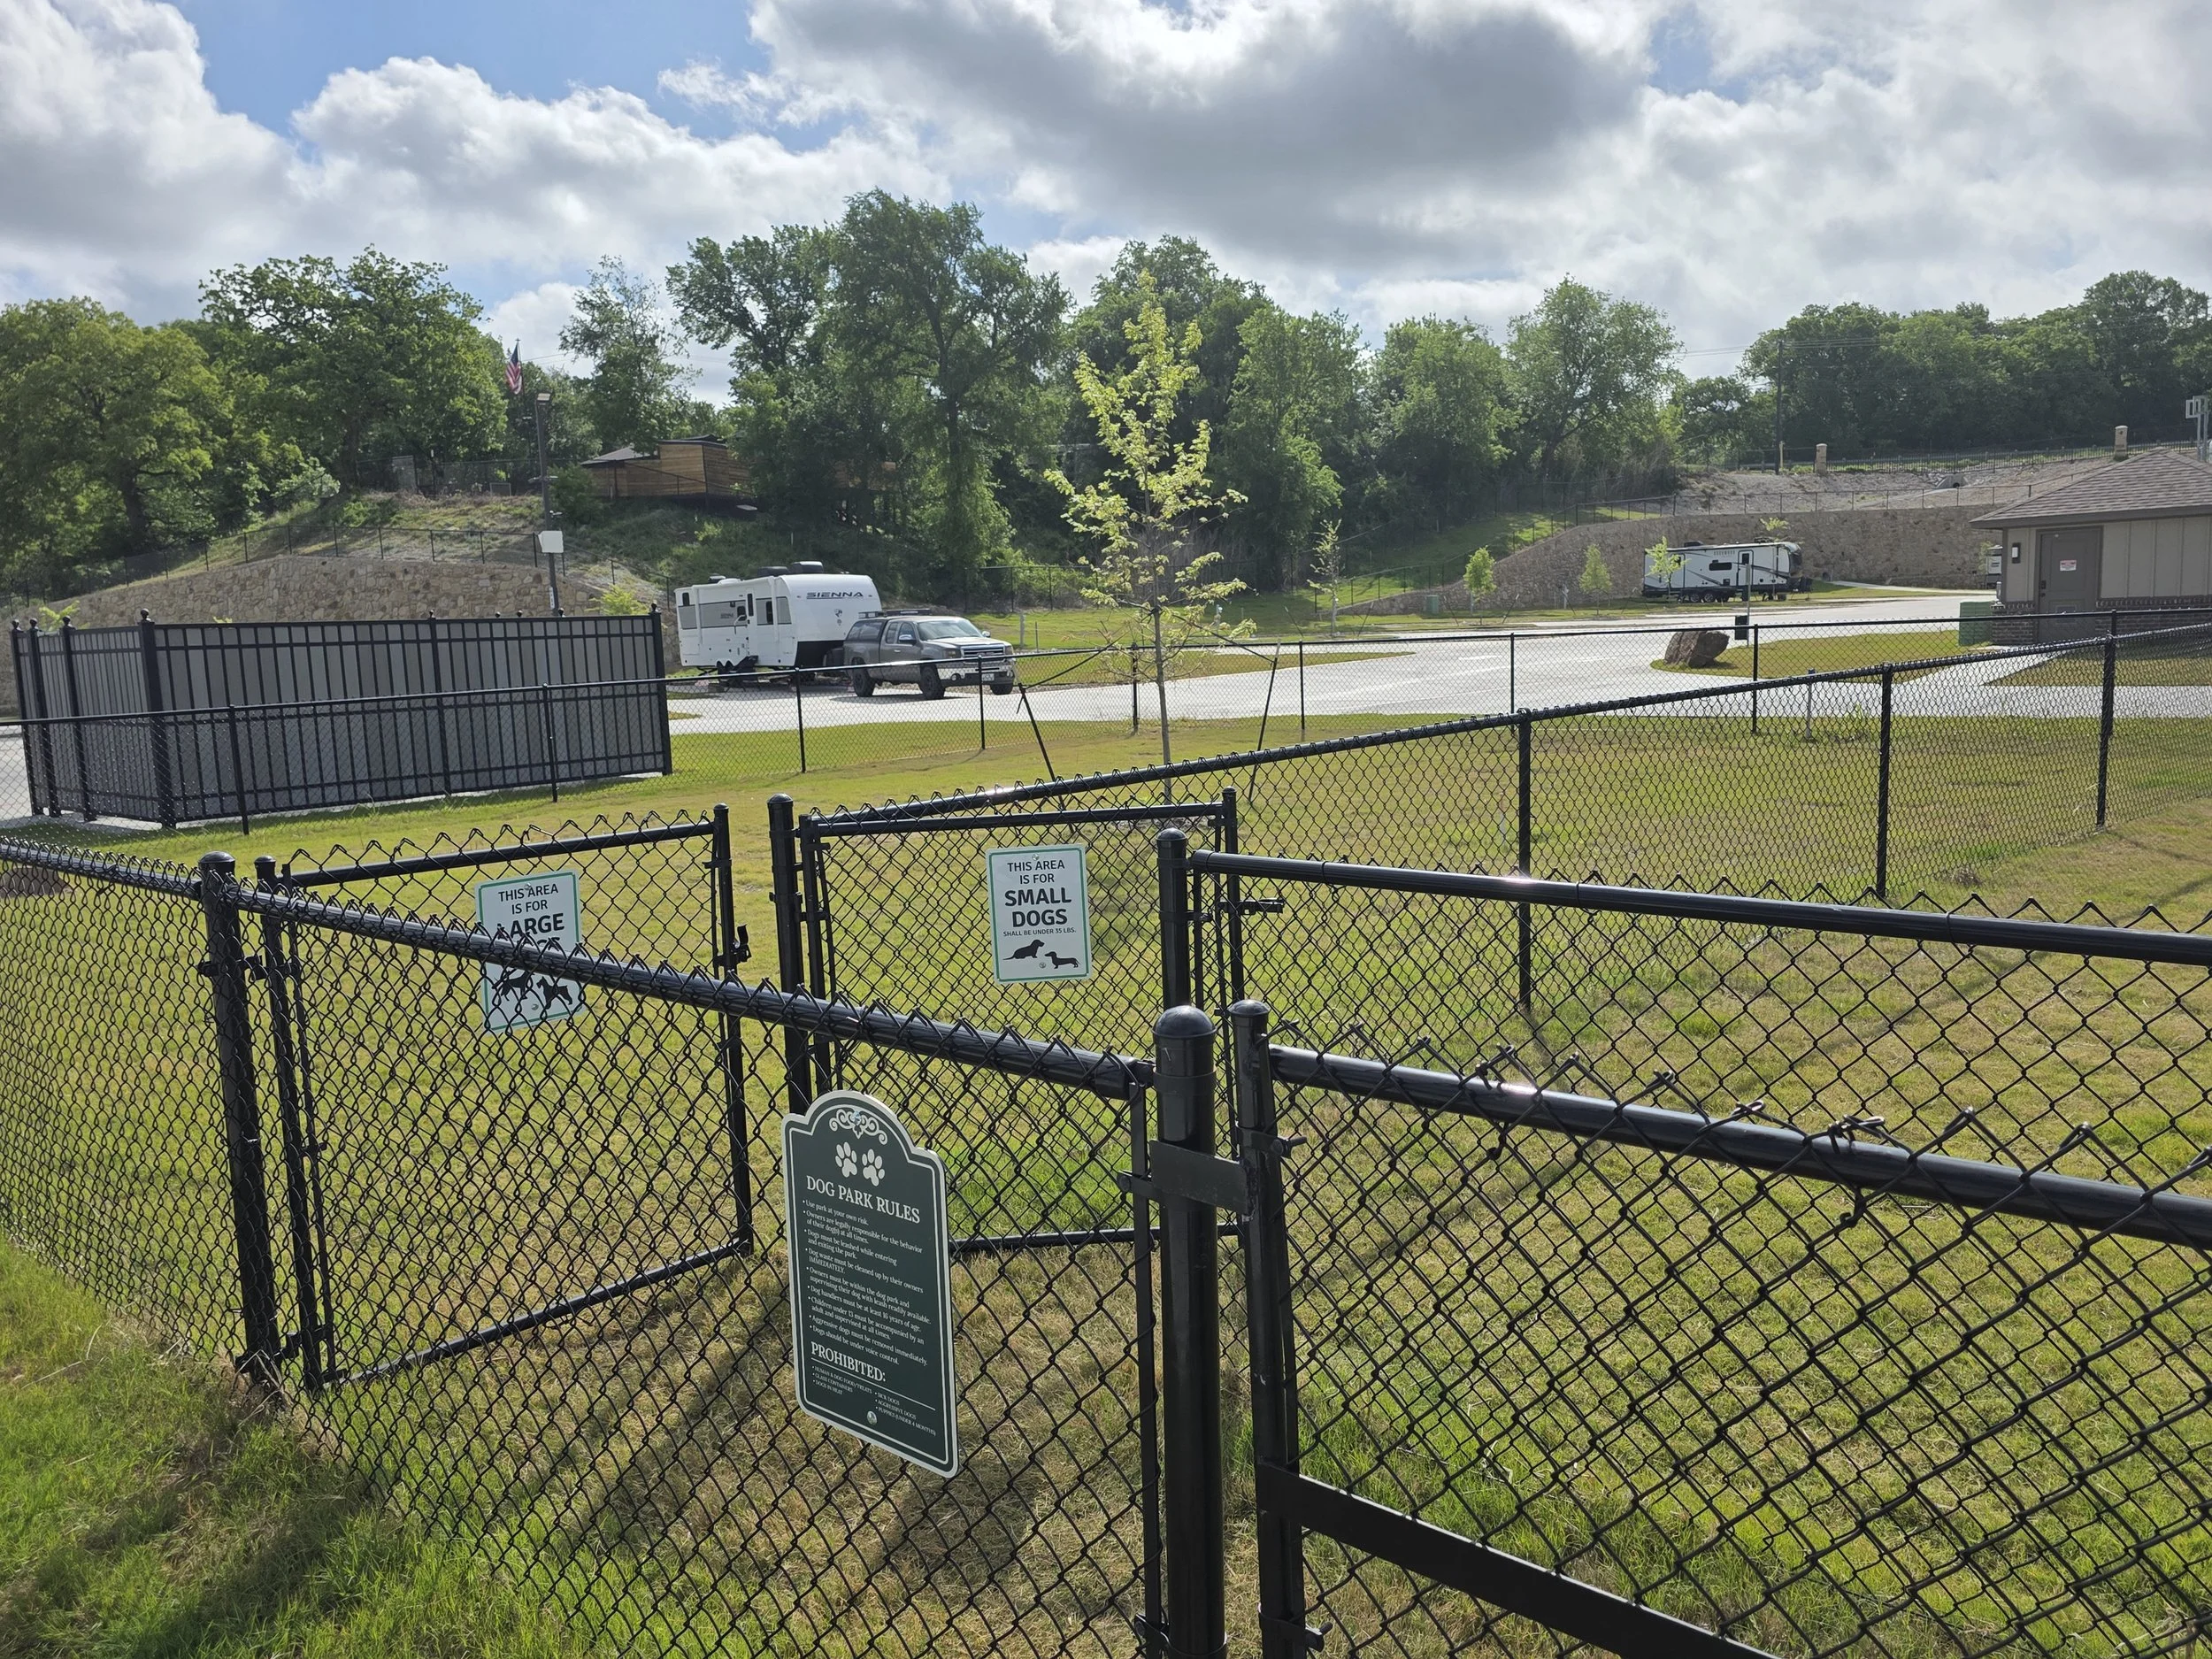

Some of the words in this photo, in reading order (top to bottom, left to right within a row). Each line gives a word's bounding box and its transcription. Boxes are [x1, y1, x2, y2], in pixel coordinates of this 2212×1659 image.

[1008, 862, 1032, 872] THIS
[1035, 860, 1064, 870] AREA
[1020, 875, 1029, 884] IS
[1033, 874, 1055, 883] FOR
[498, 888, 525, 902] THIS
[527, 884, 558, 896] AREA
[512, 903, 522, 915] IS
[526, 900, 548, 912] FOR
[1005, 887, 1071, 906] SMALL
[1012, 909, 1067, 927] DOGS
[805, 1199, 814, 1208] Use
[857, 1216, 868, 1225] risk.
[806, 1175, 834, 1197] DOG
[838, 1184, 873, 1209] PARK
[875, 1195, 920, 1224] RULES
[806, 1210, 825, 1221] Owners
[834, 1218, 850, 1231] legally
[851, 1225, 879, 1239] responsible
[889, 1236, 898, 1245] the
[899, 1240, 922, 1252] behavior
[807, 1229, 819, 1240] Dogs
[840, 1240, 859, 1251] leashed
[860, 1247, 873, 1256] while
[874, 1252, 896, 1266] entering
[812, 1219, 825, 1229] their
[825, 1224, 840, 1235] dog(s)
[853, 1233, 869, 1243] times.
[818, 1241, 834, 1253] exiting
[808, 1248, 818, 1258] Dog
[818, 1253, 833, 1262] waste
[854, 1264, 873, 1276] cleaned
[874, 1271, 881, 1280] up
[882, 1272, 889, 1283] by
[889, 1275, 902, 1286] their
[903, 1281, 923, 1293] owners
[809, 1256, 845, 1273] IMMEDIATELY.
[809, 1266, 828, 1279] Owners
[849, 1281, 865, 1292] within
[866, 1286, 875, 1295] the
[875, 1289, 886, 1301] dog
[886, 1294, 898, 1303] park
[810, 1276, 837, 1292] supervising
[838, 1285, 850, 1294] their
[850, 1289, 861, 1300] dog
[861, 1294, 873, 1302] with
[873, 1297, 887, 1308] leash
[887, 1303, 906, 1317] readily
[906, 1310, 931, 1324] available.
[810, 1286, 820, 1296] Dog
[821, 1289, 842, 1302] handlers
[869, 1307, 881, 1317] least
[888, 1315, 903, 1325] years
[810, 1295, 832, 1310] Children
[832, 1305, 848, 1316] under
[854, 1313, 867, 1323] must
[867, 1317, 874, 1325] be
[874, 1321, 908, 1338] accompanied
[909, 1332, 916, 1343] by
[811, 1305, 824, 1314] adult
[834, 1314, 861, 1328] supervised
[874, 1328, 890, 1340] times.
[812, 1315, 838, 1330] Aggressive
[838, 1325, 850, 1336] dogs
[850, 1331, 864, 1340] must
[864, 1334, 871, 1343] be
[872, 1339, 894, 1352] removed
[895, 1346, 927, 1365] immediately.
[812, 1325, 825, 1336] Dogs
[826, 1331, 841, 1342] should
[841, 1336, 849, 1345] be
[849, 1340, 864, 1351] under
[864, 1347, 878, 1356] voice
[879, 1352, 899, 1364] control.
[810, 1340, 886, 1383] PROHIBITED:
